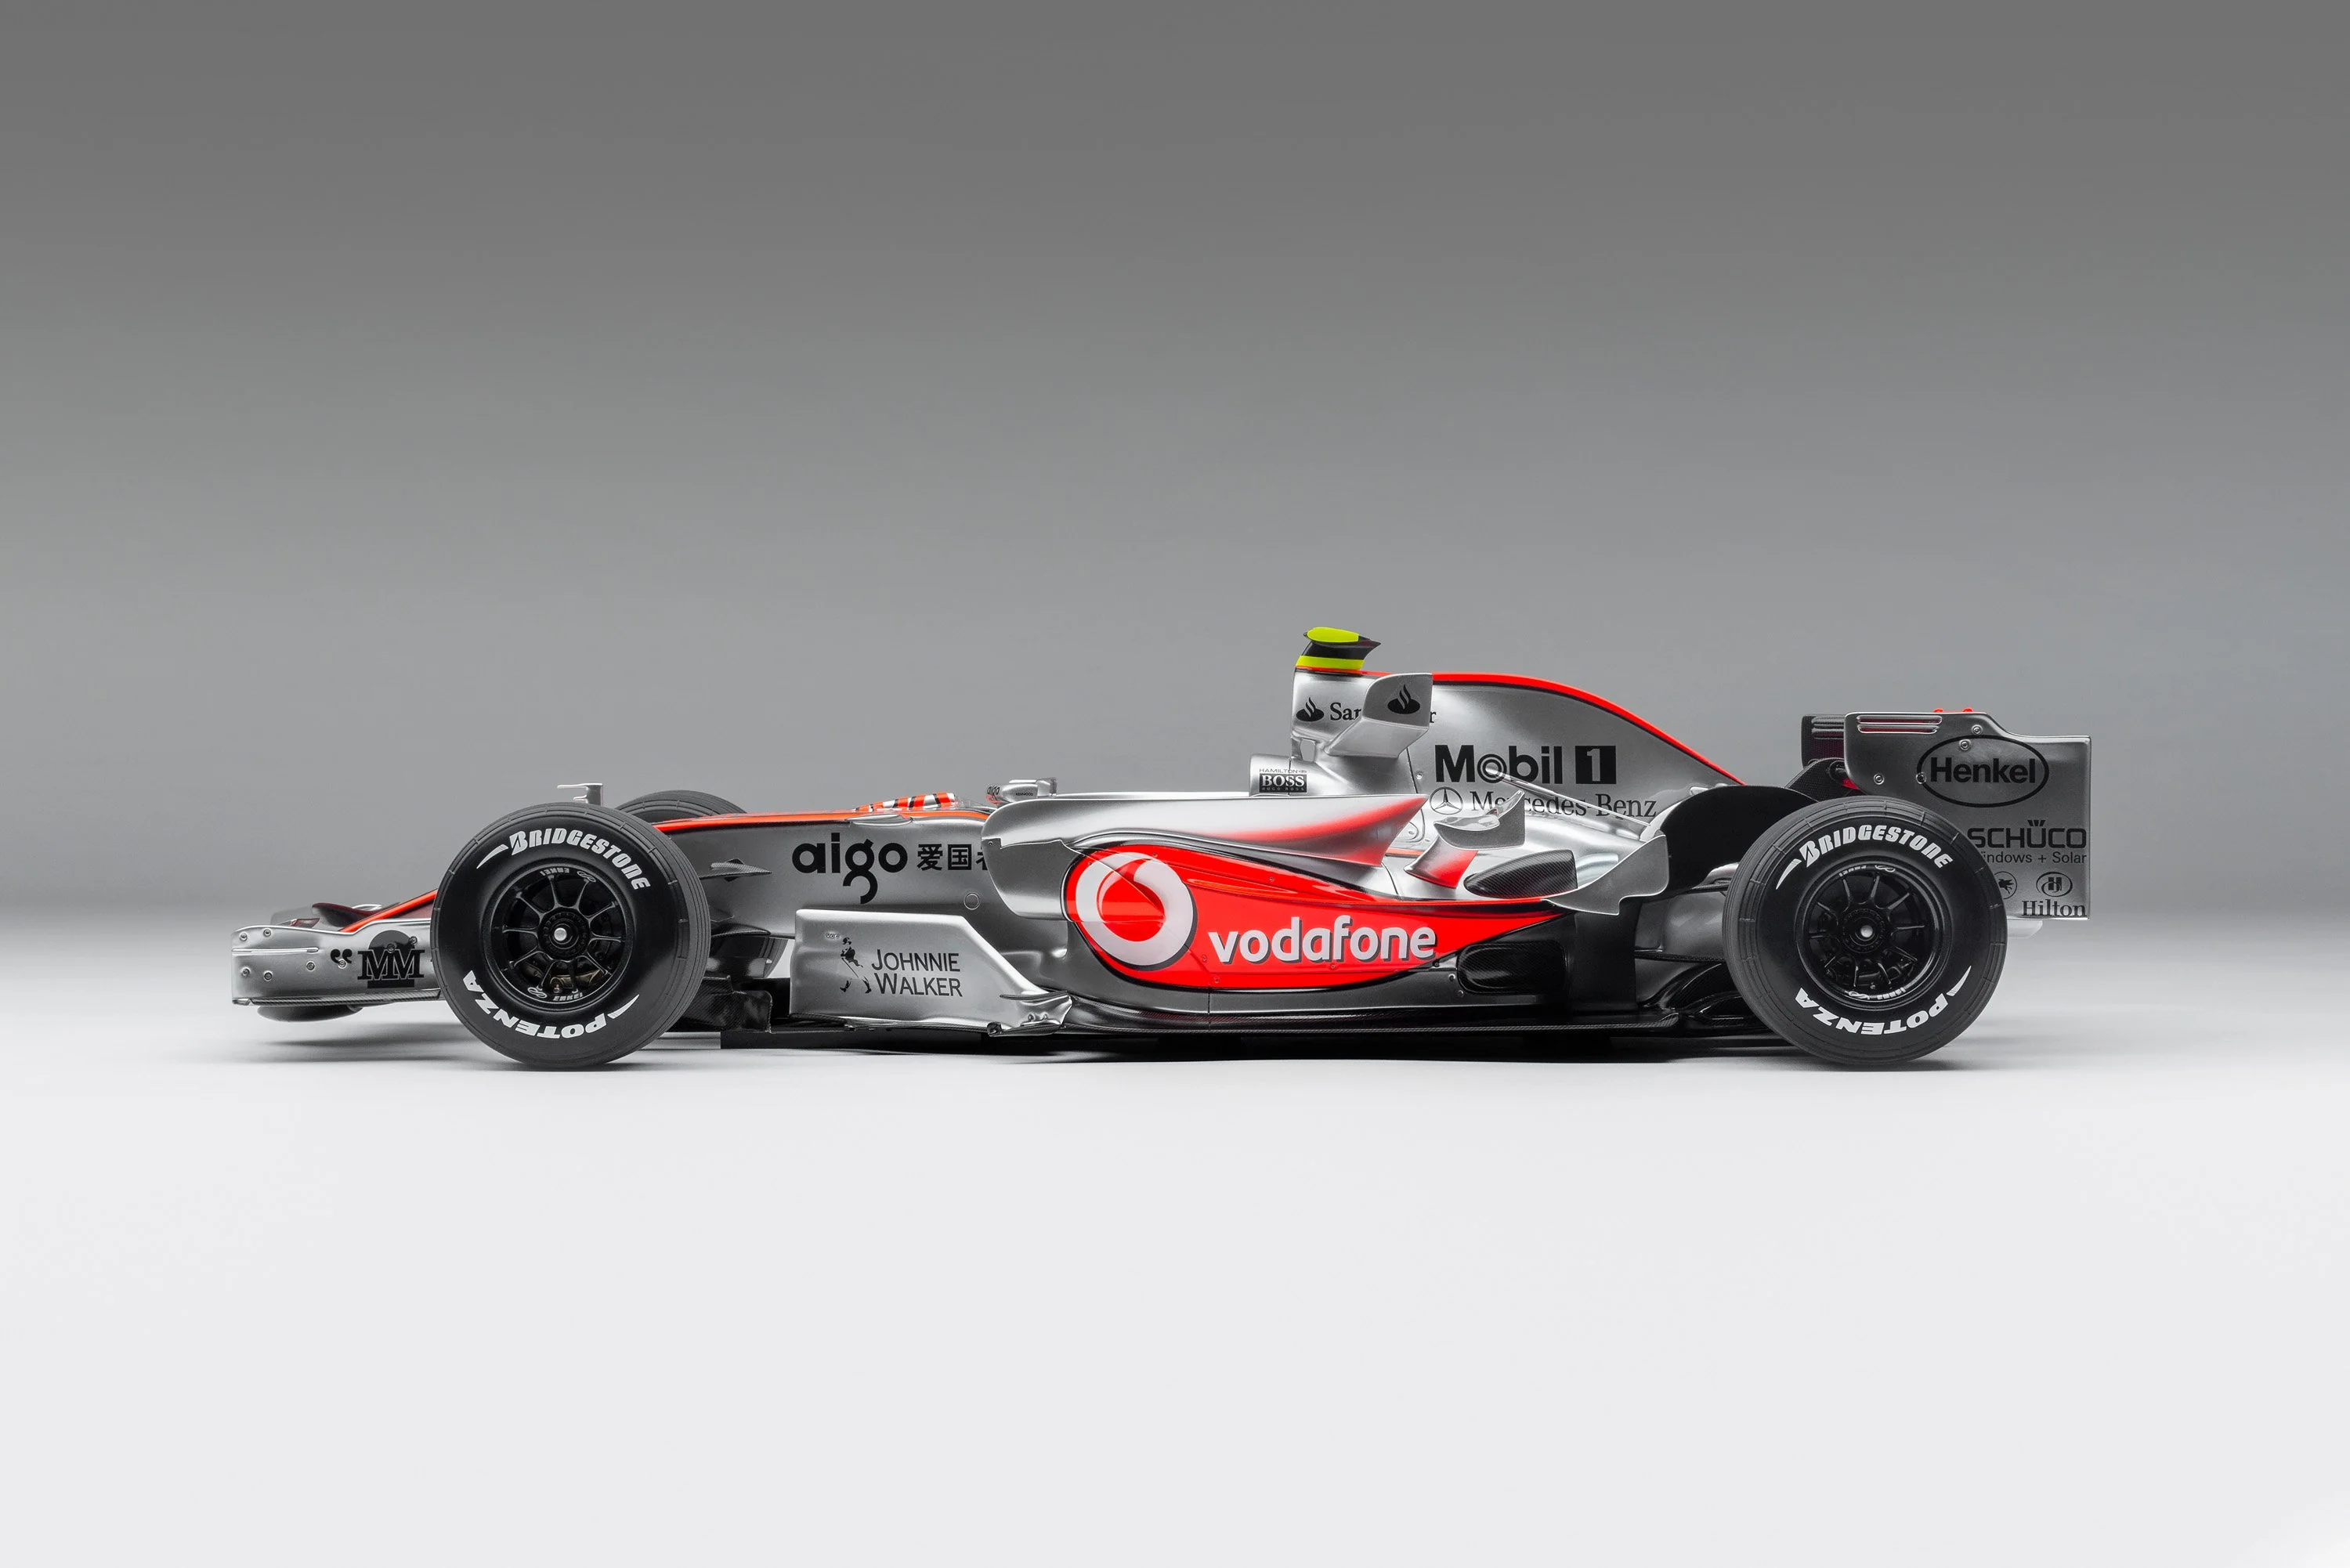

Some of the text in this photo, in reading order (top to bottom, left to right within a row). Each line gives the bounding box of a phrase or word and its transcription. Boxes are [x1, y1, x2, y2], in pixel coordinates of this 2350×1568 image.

[1435, 744, 1564, 784] Mobil
[1930, 757, 2037, 783] Henkel
[1262, 775, 1305, 786] BOSS
[1470, 791, 1658, 818] Mecedes-Benz
[1799, 825, 1953, 868] BRIDGESTONE
[1967, 820, 2087, 848] SCHÜCO
[509, 828, 651, 890] BRIDGESTONE
[792, 833, 909, 905] aigo
[1981, 851, 2033, 863] indows
[2052, 851, 2088, 863] Solar
[2022, 899, 2087, 917] Hilton
[1208, 915, 1437, 964] vodafone
[871, 949, 960, 972] JOHNNIE
[874, 973, 963, 997] WALKER
[463, 970, 606, 1039] POTENZA
[1795, 988, 1948, 1035] POTENZA
